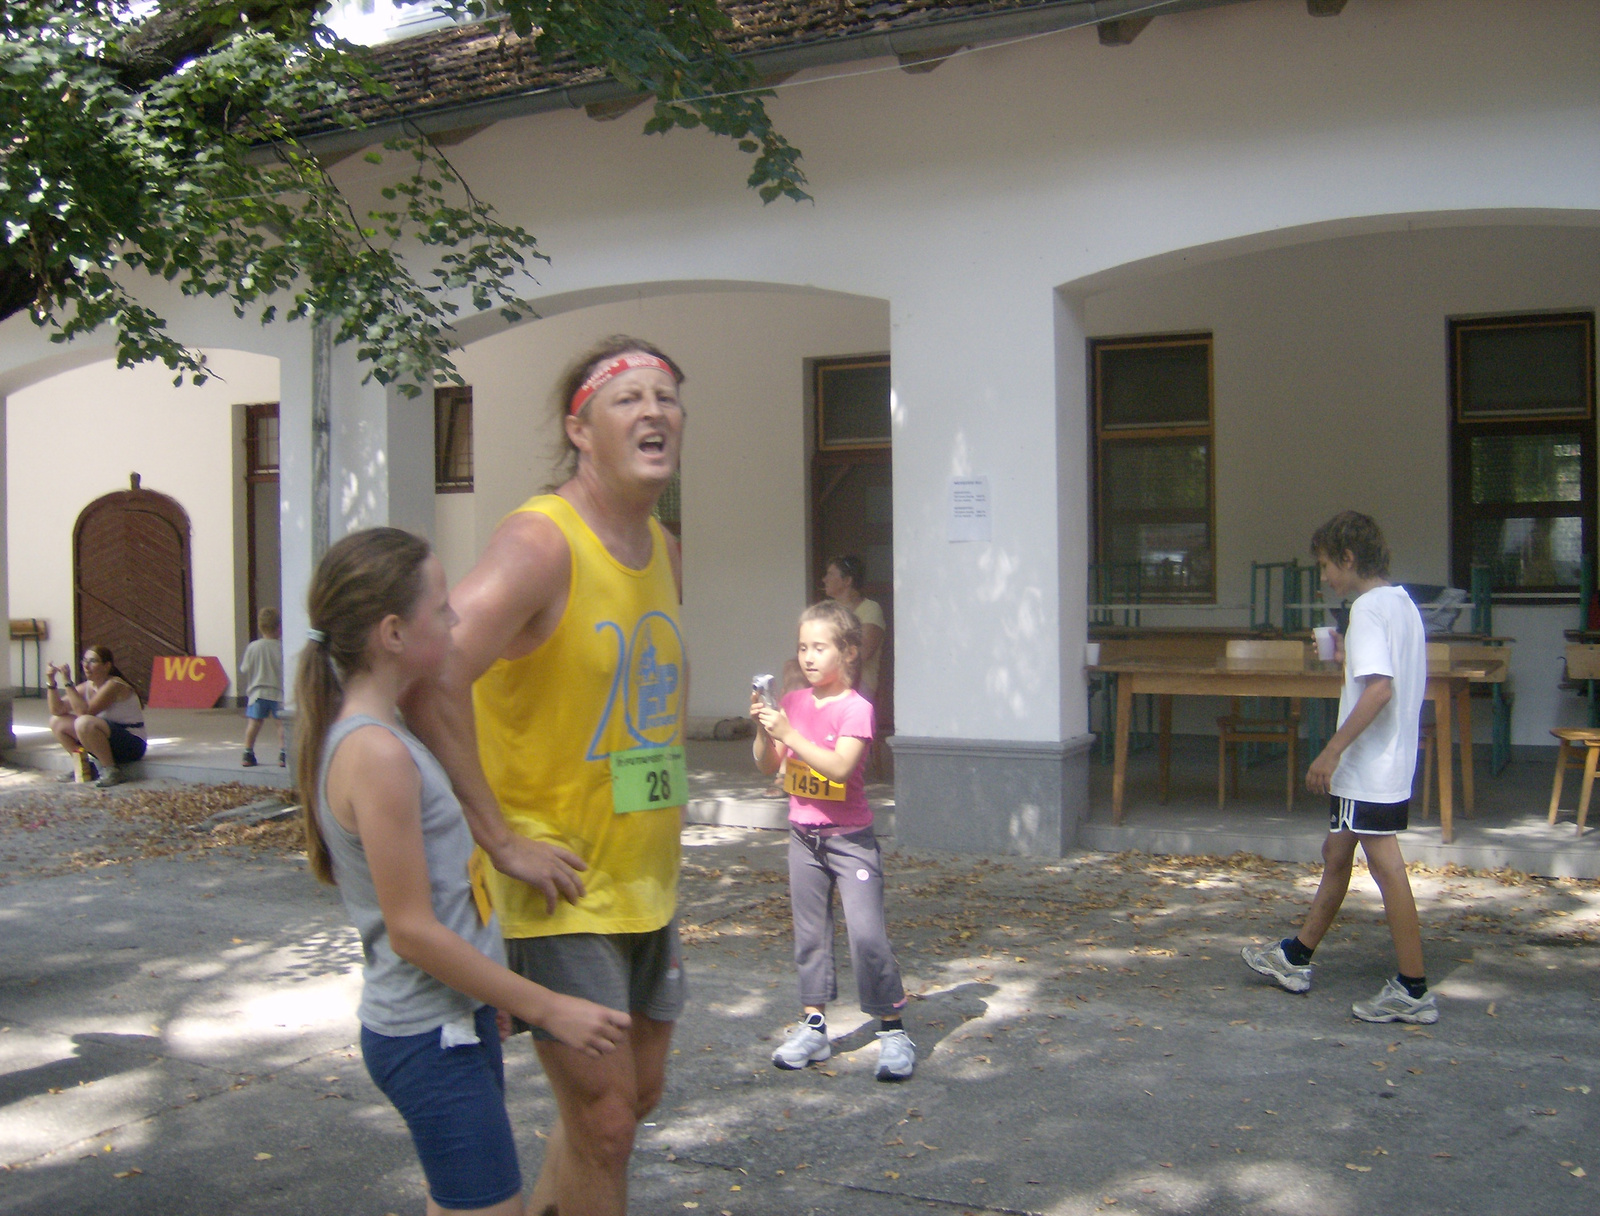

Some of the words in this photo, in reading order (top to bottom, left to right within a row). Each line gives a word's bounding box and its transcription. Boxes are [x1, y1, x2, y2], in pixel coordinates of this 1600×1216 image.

[164, 657, 207, 682] WC
[585, 611, 687, 761] 20
[646, 769, 671, 802] 28
[792, 773, 830, 796] 1451
